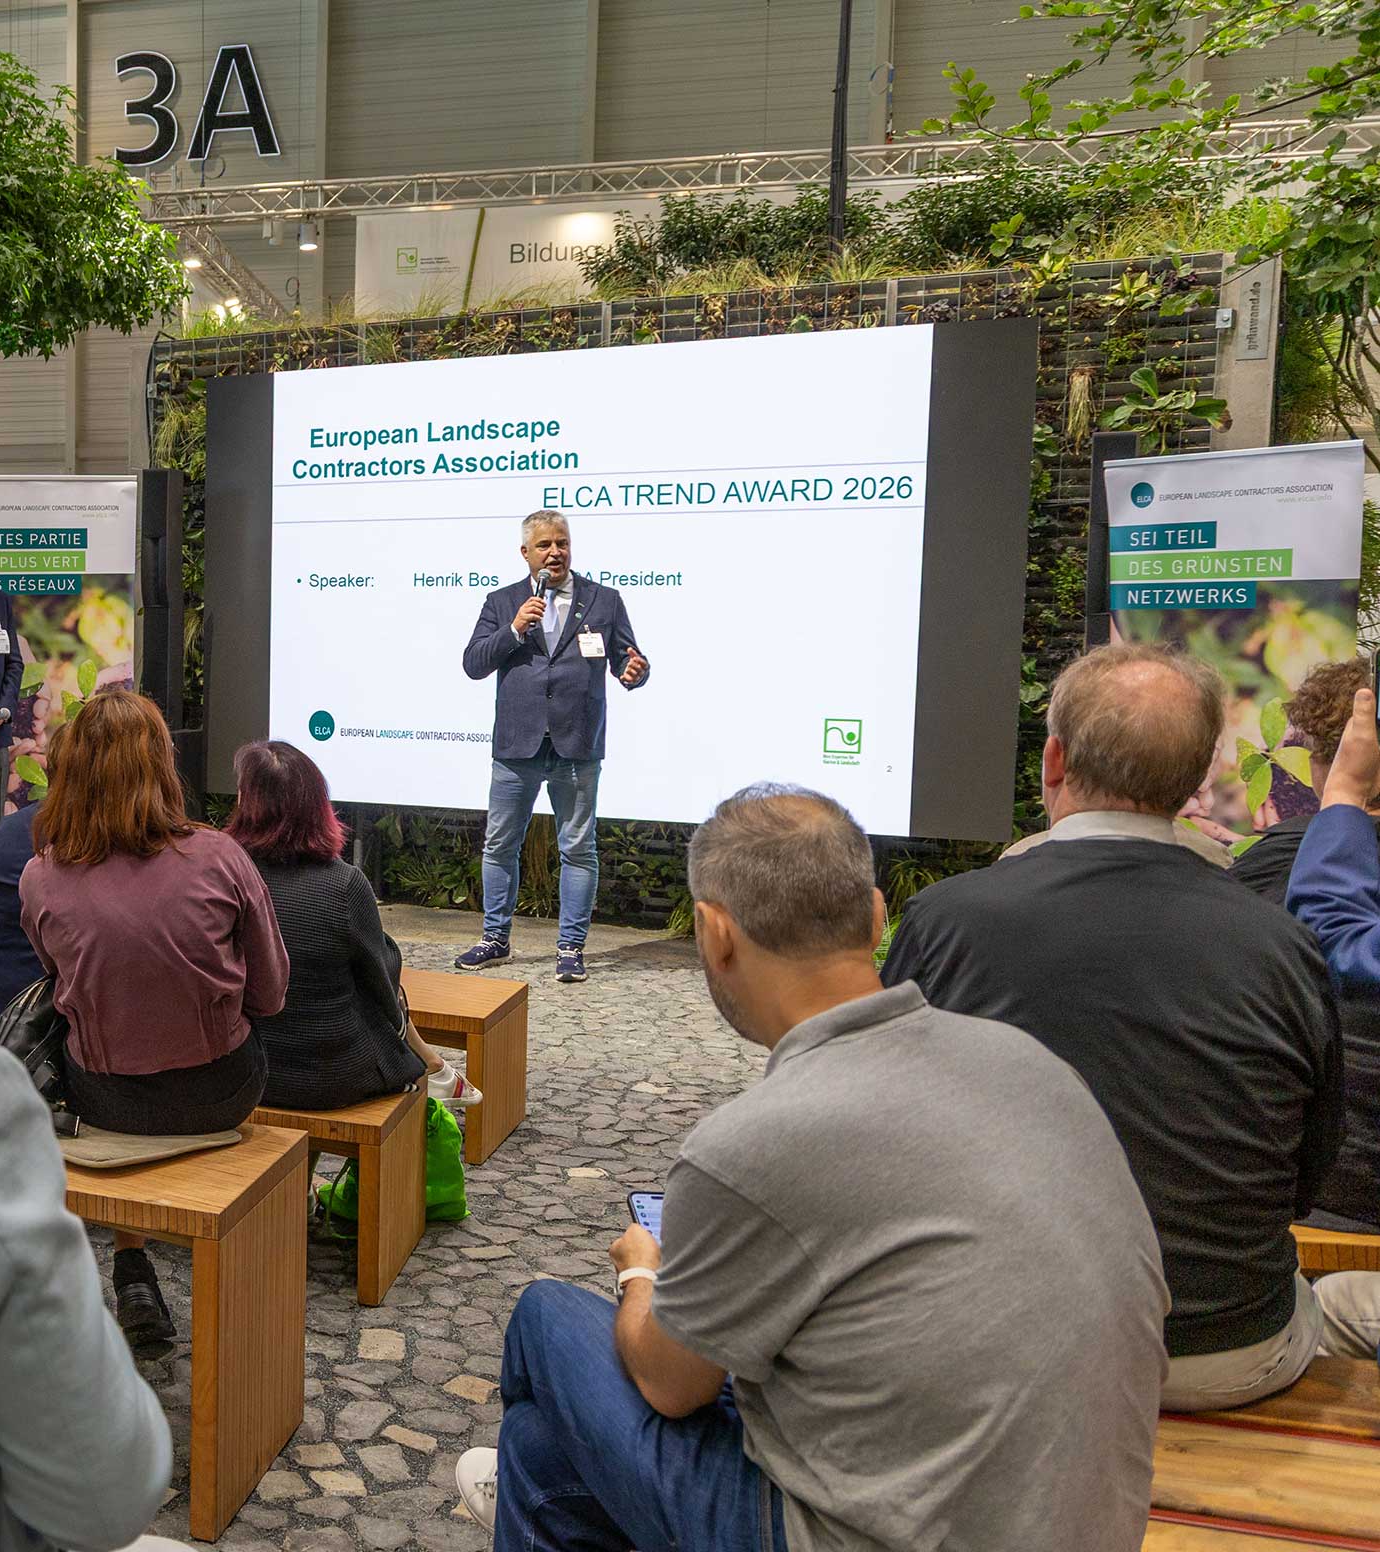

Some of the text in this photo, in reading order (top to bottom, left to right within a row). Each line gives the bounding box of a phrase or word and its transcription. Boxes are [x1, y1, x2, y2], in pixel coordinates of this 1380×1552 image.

[115, 44, 281, 167] 3A
[310, 419, 560, 450] European Landscape
[292, 450, 578, 479] Contractors Association
[543, 475, 913, 509] ELCA TREND AWARD 2026
[1159, 483, 1333, 502] EUROPEAN LANDSCAPE CONTRACTORS ASSOCIATION
[30, 533, 81, 545] PARTIE
[1130, 529, 1208, 547] SEI TEIL
[0, 556, 79, 568] PLUS VERT
[1129, 556, 1282, 576] DES GRÜNSTEN
[9, 577, 76, 591] RÉSEAUX
[309, 573, 375, 592] Speaker:
[413, 572, 462, 588] Henrik
[468, 572, 499, 588] Bos
[600, 571, 683, 588] President
[1127, 588, 1247, 604] NETZWERKS
[315, 727, 331, 735] ELCA
[340, 728, 374, 738] EUROPEAN
[375, 730, 414, 739] LANDSCAPE
[416, 731, 465, 741] CONTRACTORS
